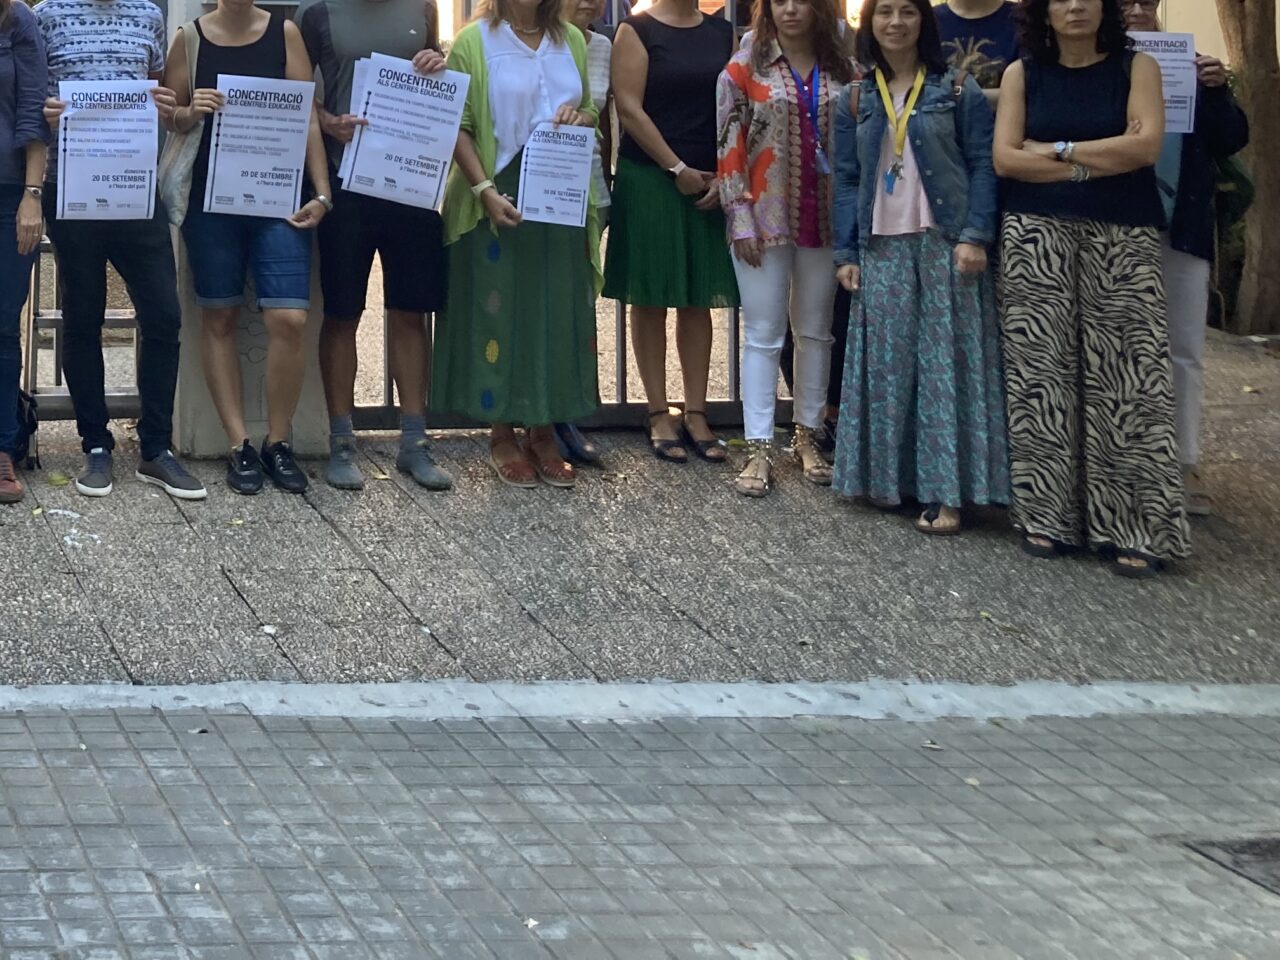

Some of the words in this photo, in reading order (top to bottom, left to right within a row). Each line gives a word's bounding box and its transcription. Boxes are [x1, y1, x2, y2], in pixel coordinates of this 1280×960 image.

[379, 68, 456, 95] CONCENTRACIÓ
[71, 92, 147, 103] CONCENTRACIÓ
[228, 88, 303, 104] CONCENTRACIÓ
[377, 79, 389, 87] ALS
[390, 82, 418, 94] CENTRES
[420, 89, 454, 102] EDUCATIUS
[268, 102, 301, 111] EDUCATIUS
[533, 130, 587, 142] CONCENTRACIÓ
[394, 155, 403, 163] DE
[405, 158, 439, 171] SETEMBRE
[260, 172, 293, 180] SETEMBRE
